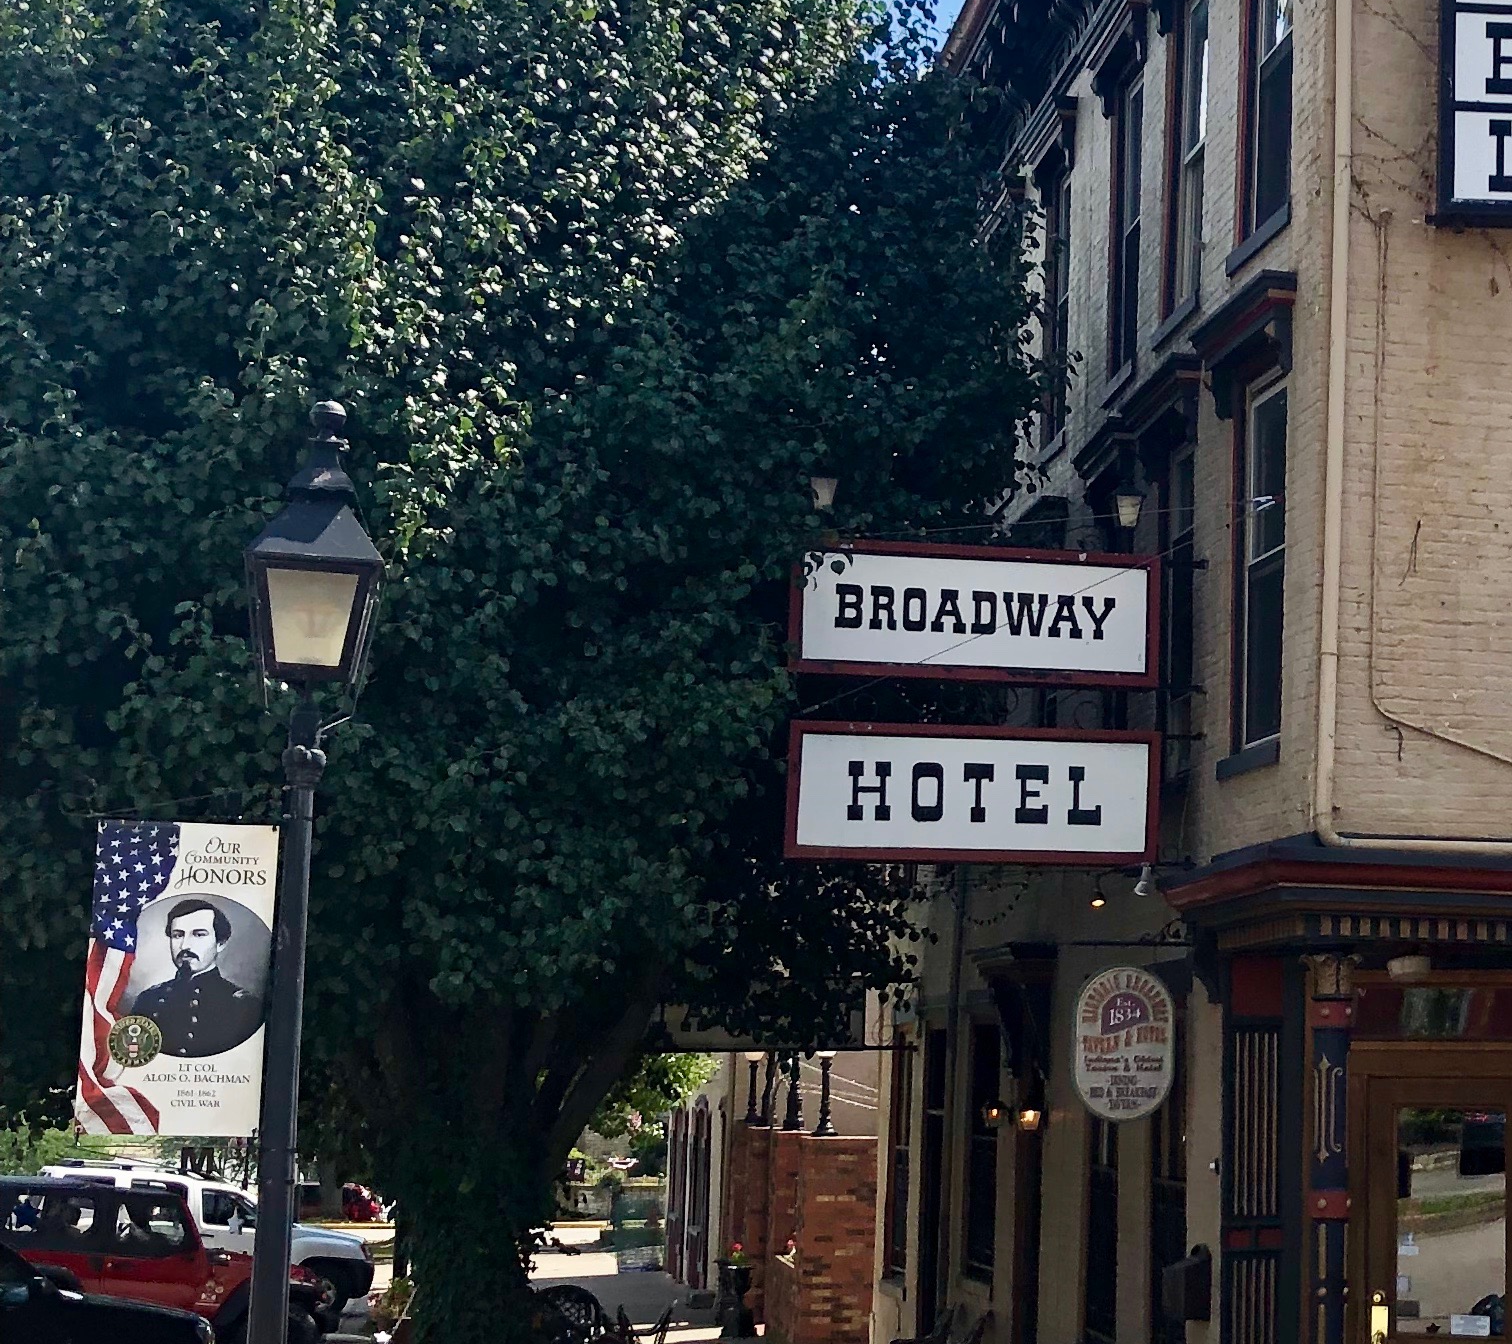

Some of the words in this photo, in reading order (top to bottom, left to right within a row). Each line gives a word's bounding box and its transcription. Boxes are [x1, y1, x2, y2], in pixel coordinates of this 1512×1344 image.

[834, 582, 1117, 641] BROADWAY
[846, 760, 1102, 826] HOTEL
[184, 850, 260, 866] COMMUNITY
[173, 865, 267, 889] HONORS
[1109, 1008, 1141, 1026] 1834
[178, 1063, 192, 1073] LT
[194, 1063, 217, 1073] COL
[142, 1073, 177, 1083] ALOIS
[194, 1074, 251, 1084] BACHMAN
[170, 1099, 197, 1108] CIVIL
[199, 1099, 220, 1108] WAR
